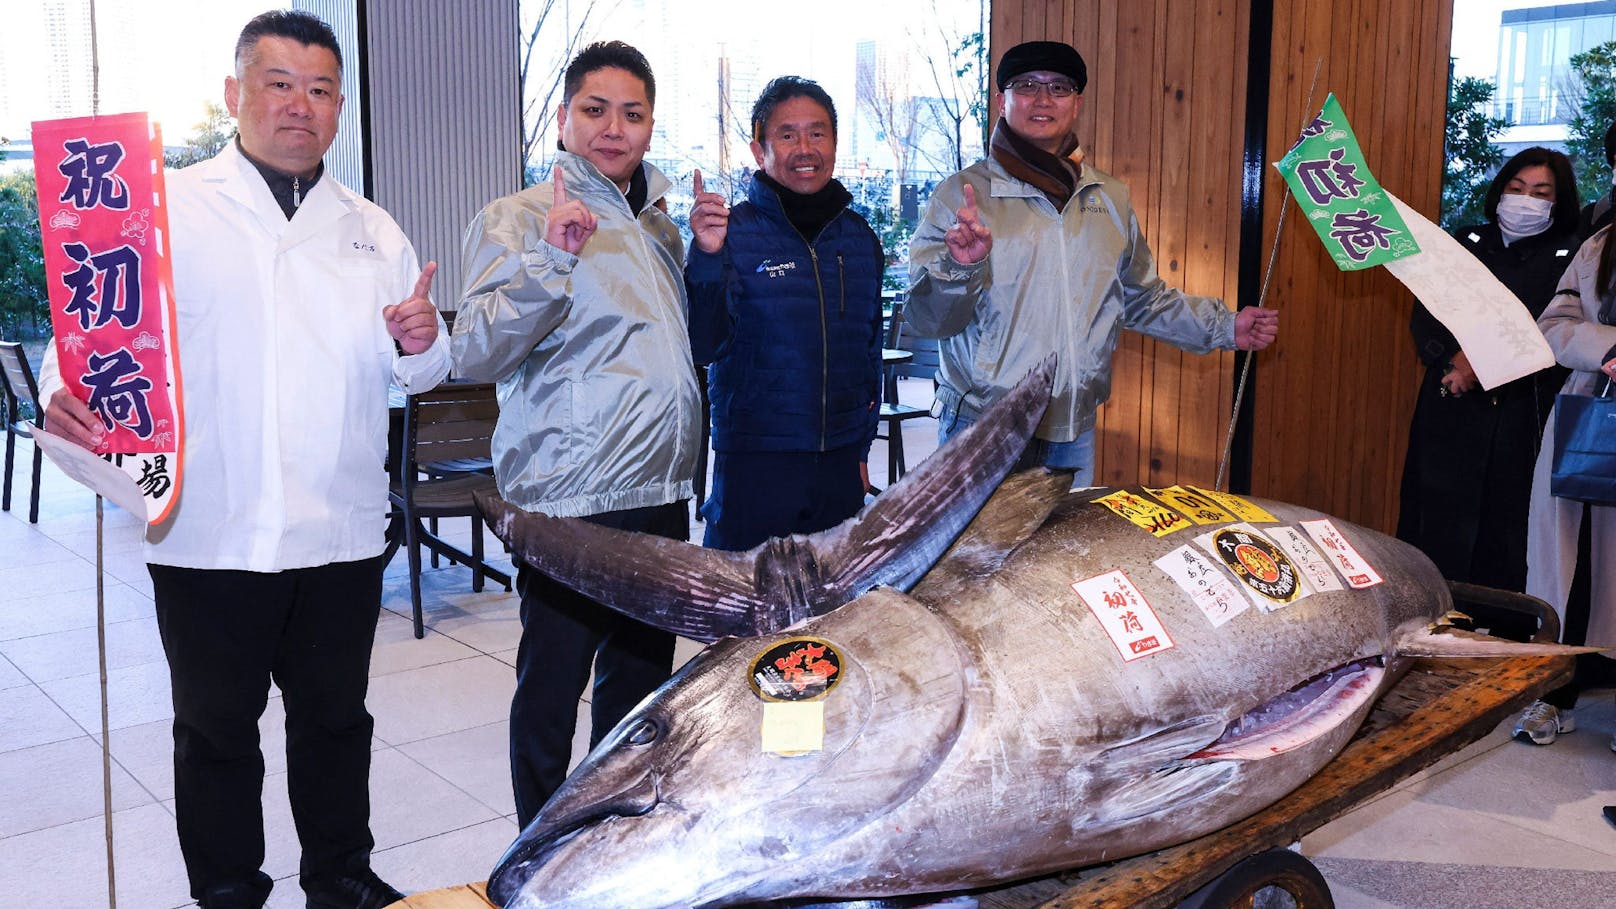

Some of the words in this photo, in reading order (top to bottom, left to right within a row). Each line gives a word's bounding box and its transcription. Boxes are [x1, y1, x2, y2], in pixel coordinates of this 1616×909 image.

[60, 138, 153, 439] 祝初荷
[1102, 591, 1144, 633] 初荷
